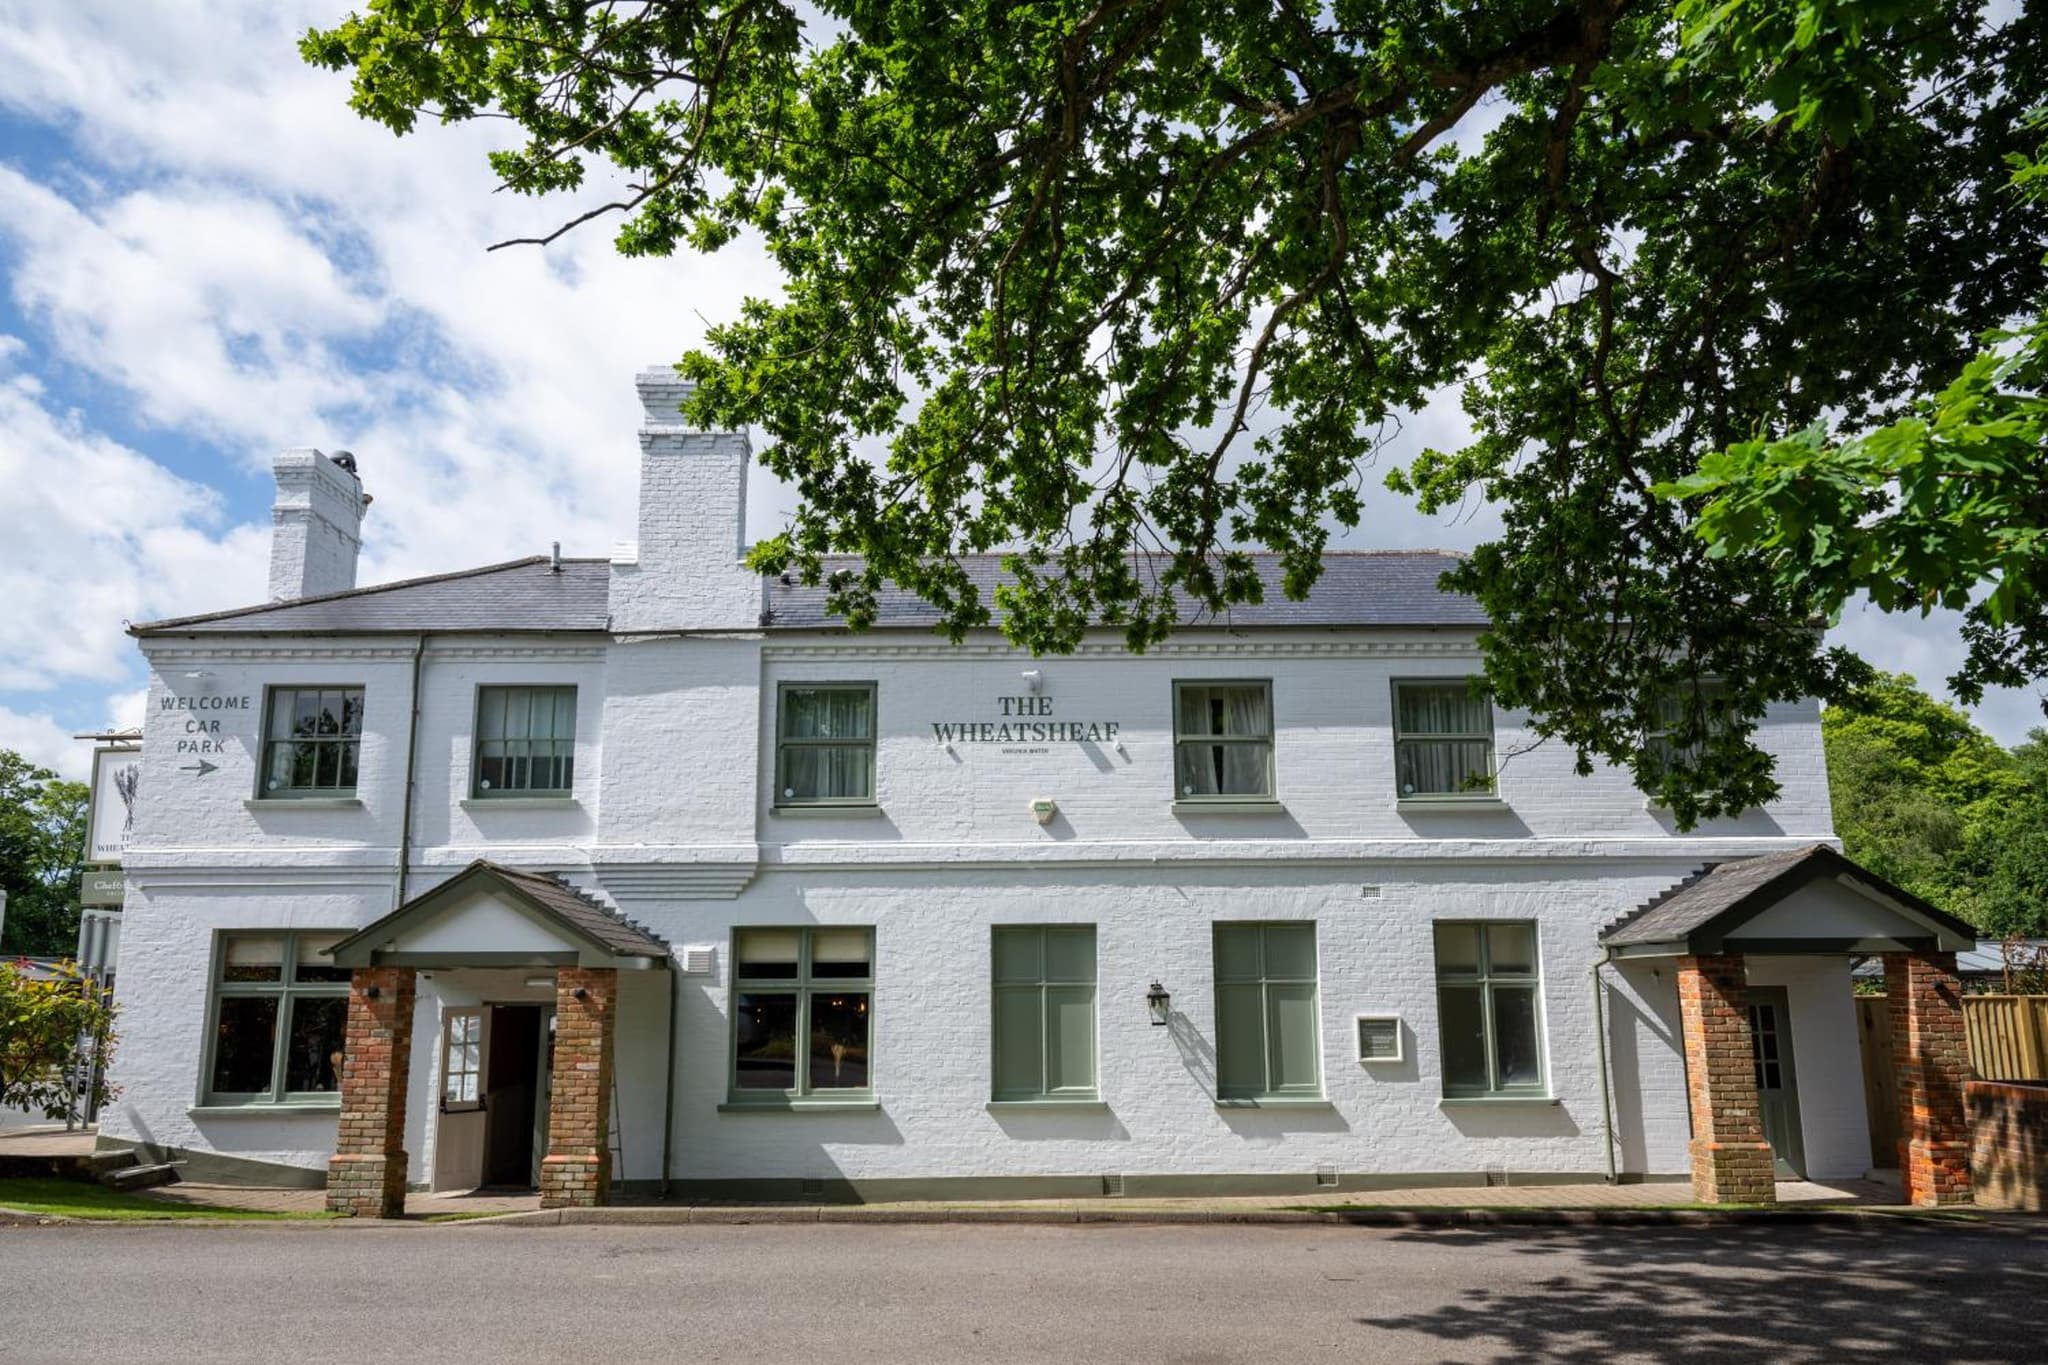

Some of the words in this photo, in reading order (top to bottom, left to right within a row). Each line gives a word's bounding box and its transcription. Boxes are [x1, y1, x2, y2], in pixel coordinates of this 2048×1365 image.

[161, 696, 250, 711] WELCOME
[998, 696, 1053, 716] THE
[185, 720, 221, 734] CAR
[931, 722, 1120, 743] WHEATSHEAF
[177, 740, 225, 753] PARK
